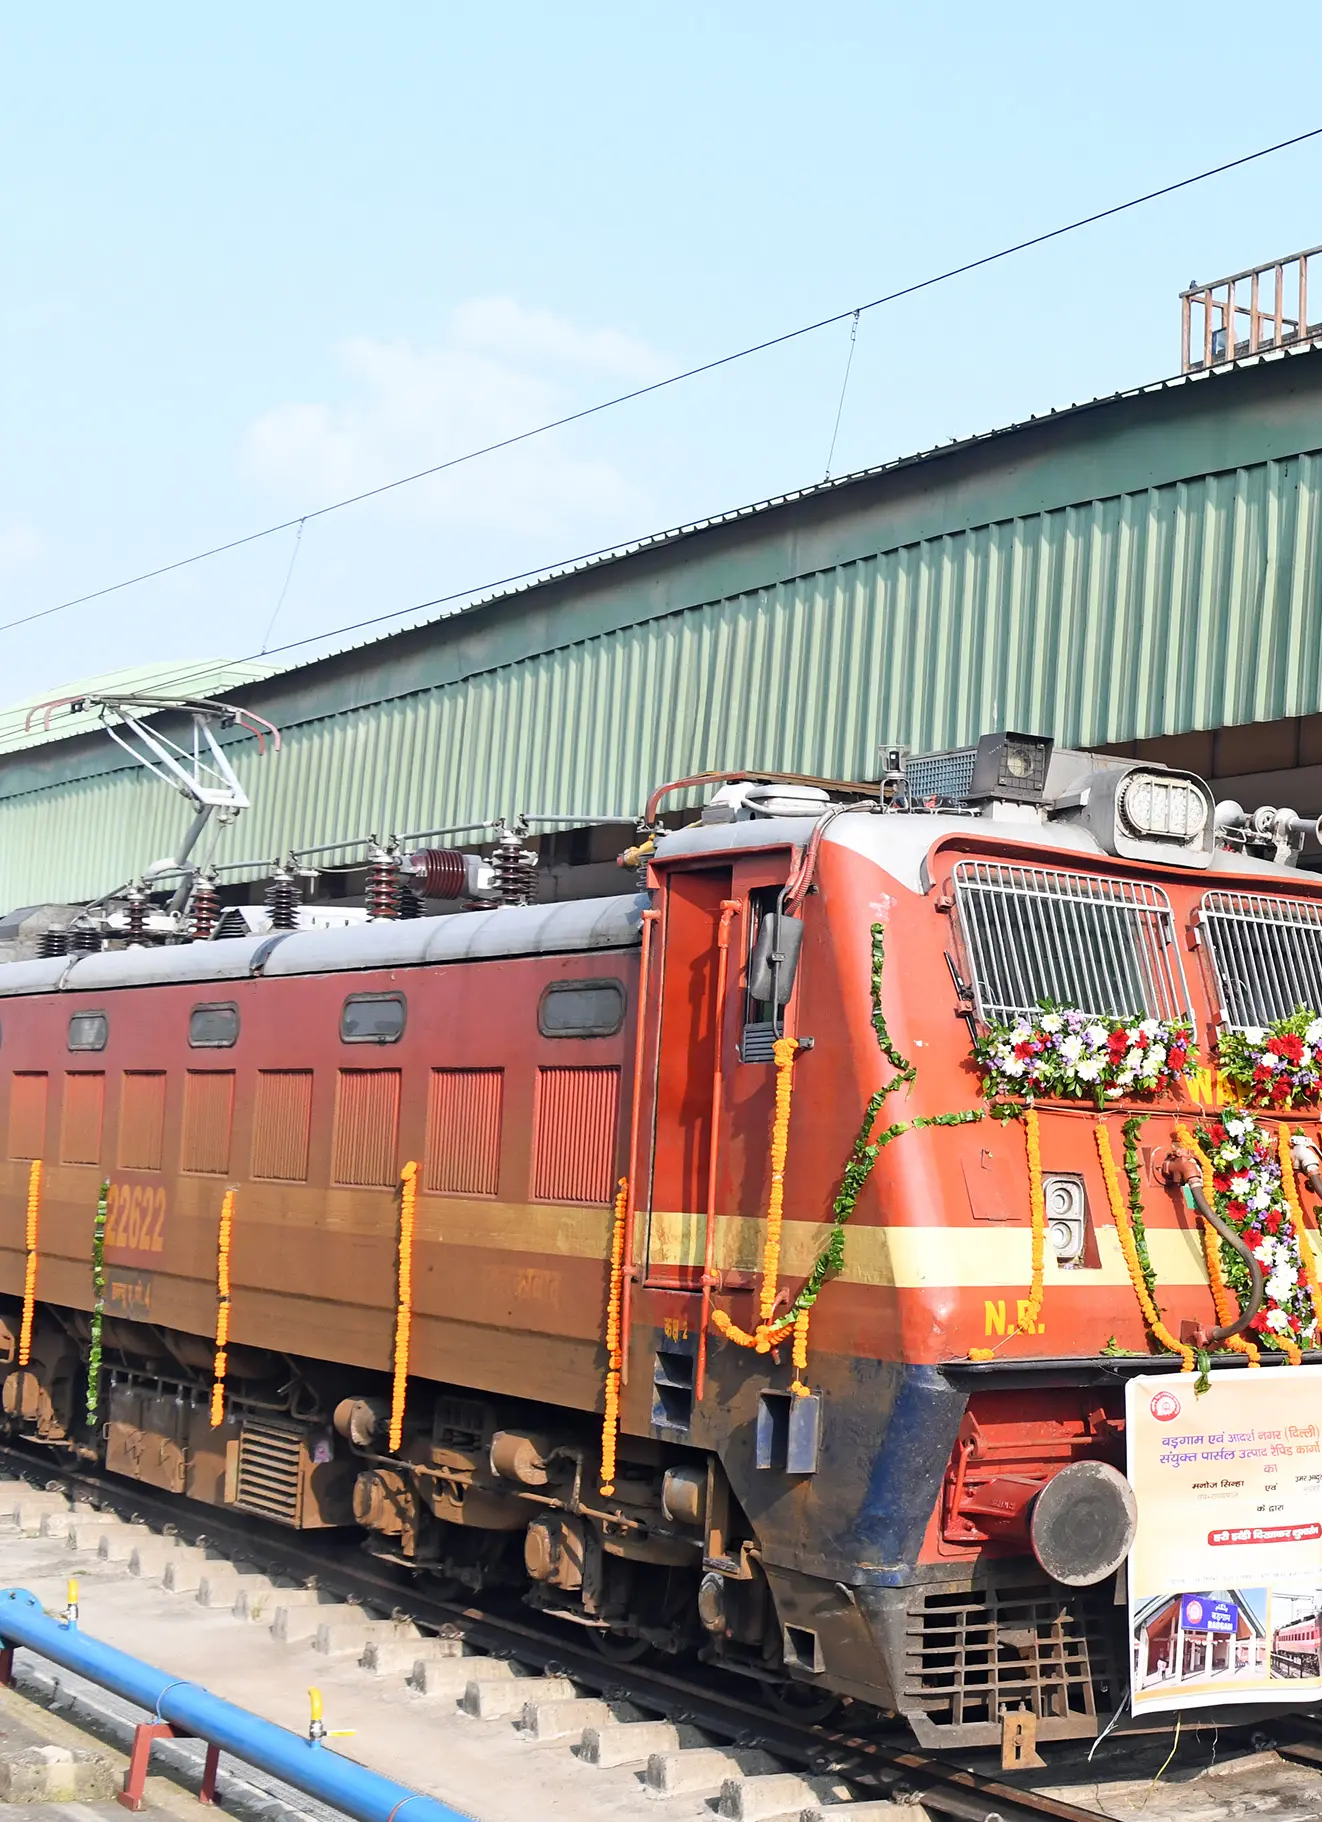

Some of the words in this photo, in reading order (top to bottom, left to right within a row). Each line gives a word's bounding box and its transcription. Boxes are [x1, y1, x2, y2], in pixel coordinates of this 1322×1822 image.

[104, 1184, 166, 1252] 22622
[1208, 1431, 1225, 1445] एवं
[1228, 1429, 1254, 1443] आदर्श
[1258, 1430, 1282, 1440] नगर
[1284, 1425, 1320, 1441] (दिल्ली)
[1160, 1451, 1198, 1468] संयुक्त
[1200, 1447, 1235, 1460] पार्सल
[1238, 1448, 1267, 1459] उत्पाद
[1270, 1444, 1292, 1457] रैपिड
[1295, 1441, 1320, 1454] कार्गो
[1263, 1463, 1278, 1474] का
[1192, 1480, 1218, 1490] मनोज
[1220, 1479, 1244, 1488] सिन्हा
[1264, 1483, 1278, 1492] एवं
[1256, 1504, 1266, 1512] के
[1268, 1504, 1284, 1512] द्वारा
